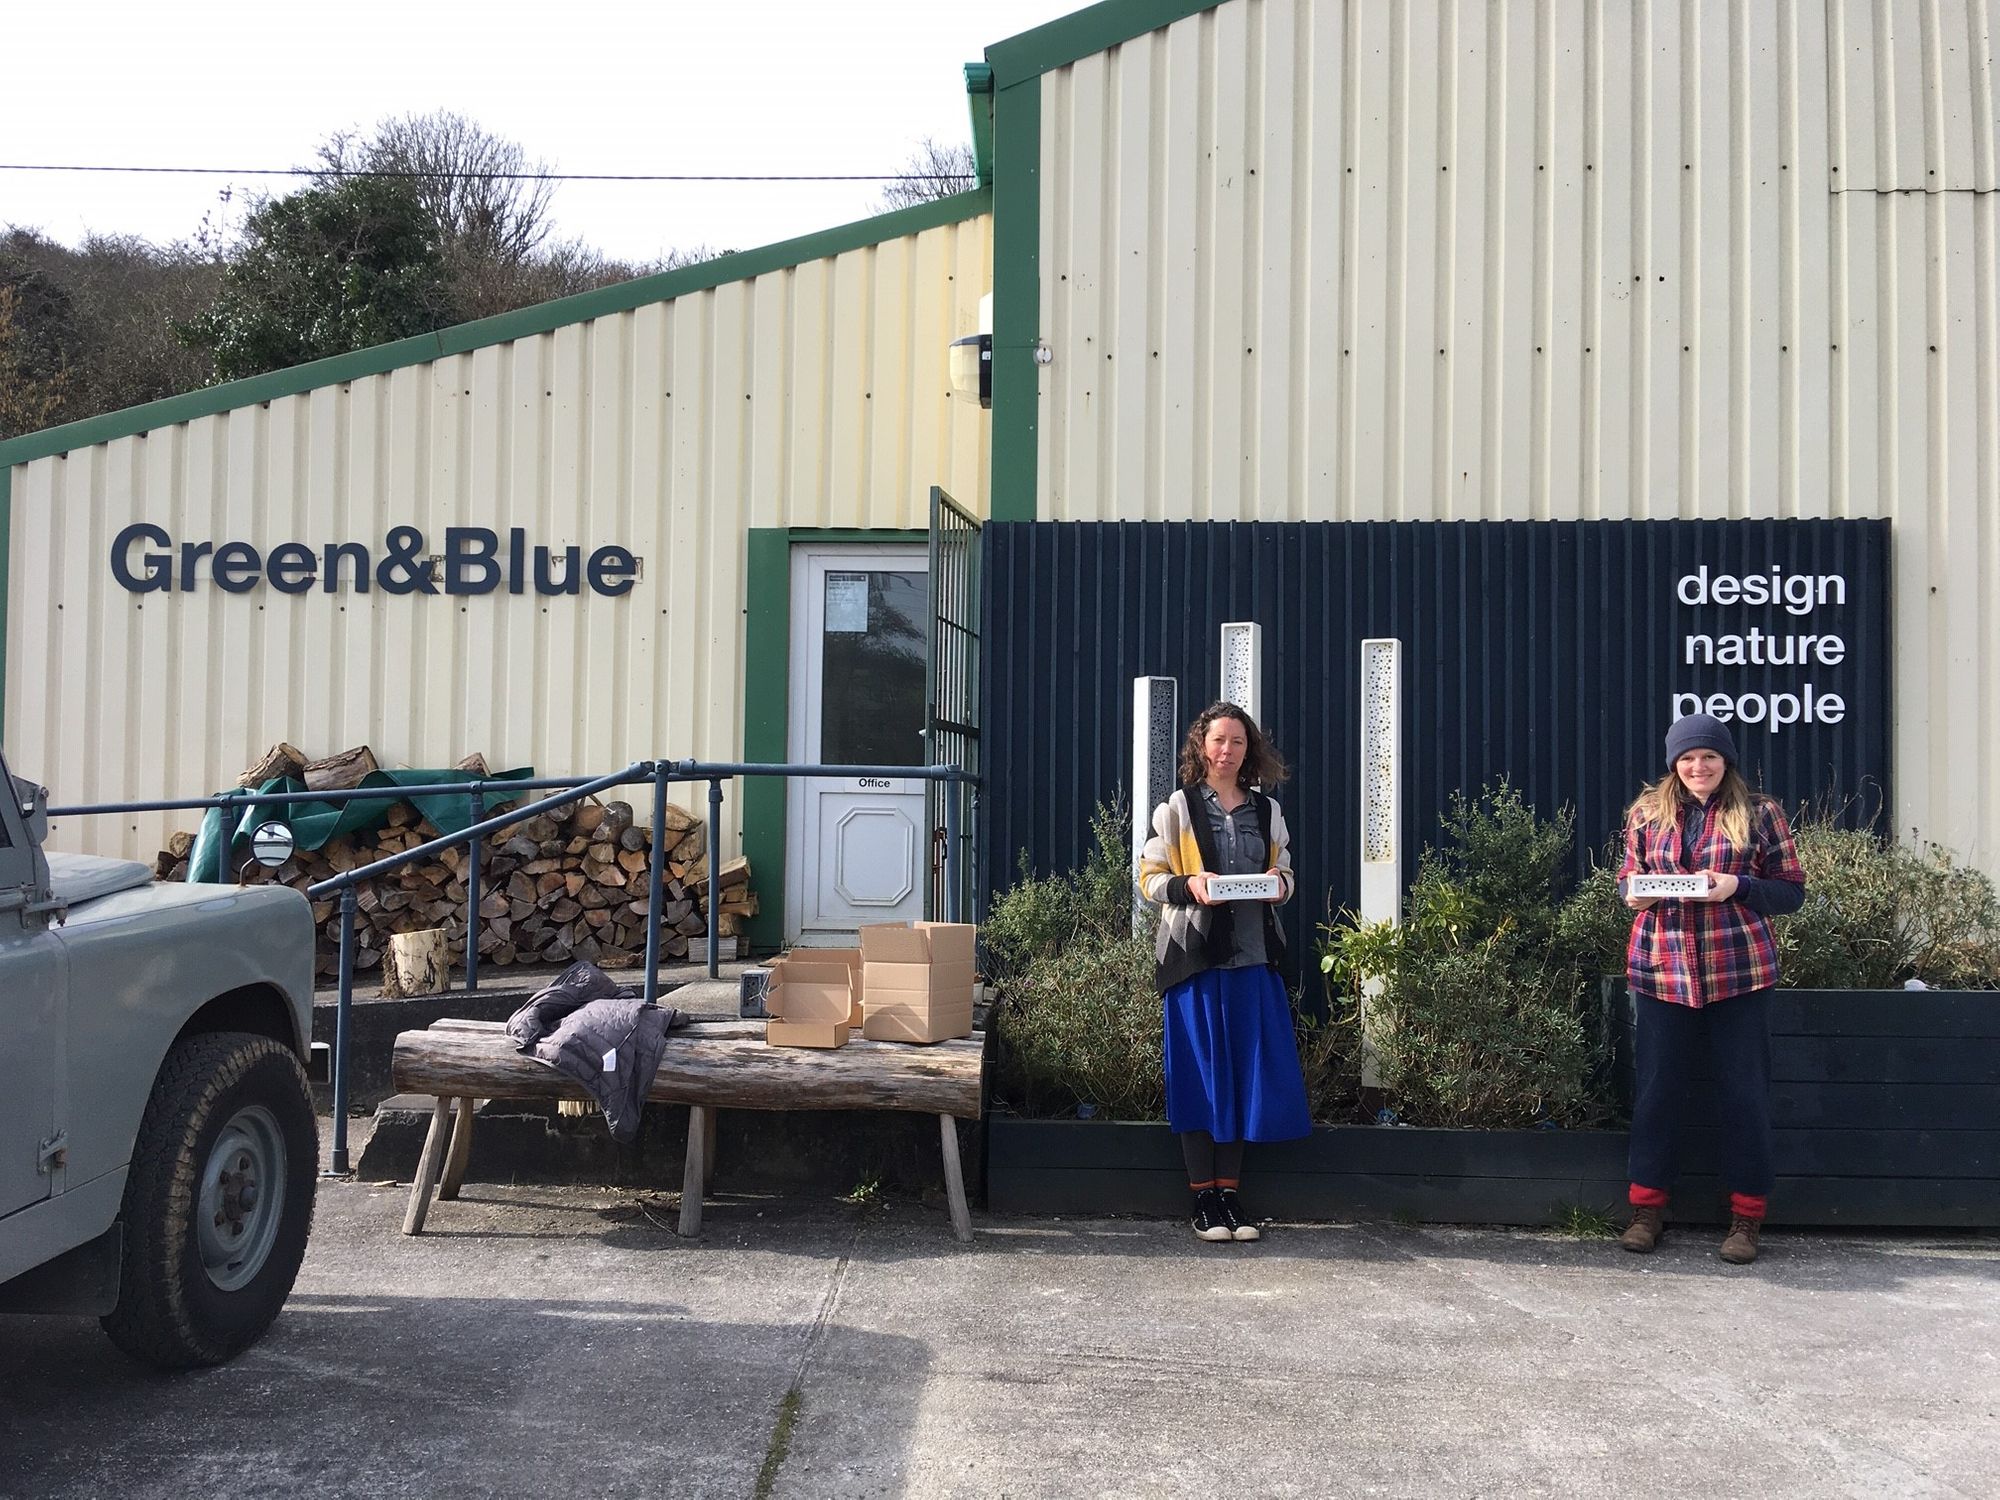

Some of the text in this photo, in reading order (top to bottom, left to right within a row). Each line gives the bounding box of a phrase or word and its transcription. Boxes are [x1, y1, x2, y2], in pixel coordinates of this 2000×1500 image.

[110, 522, 638, 596] Green&Blue
[1677, 564, 1846, 616] design
[1685, 627, 1846, 666] nature
[1672, 683, 1846, 733] people
[858, 777, 891, 788] Office
